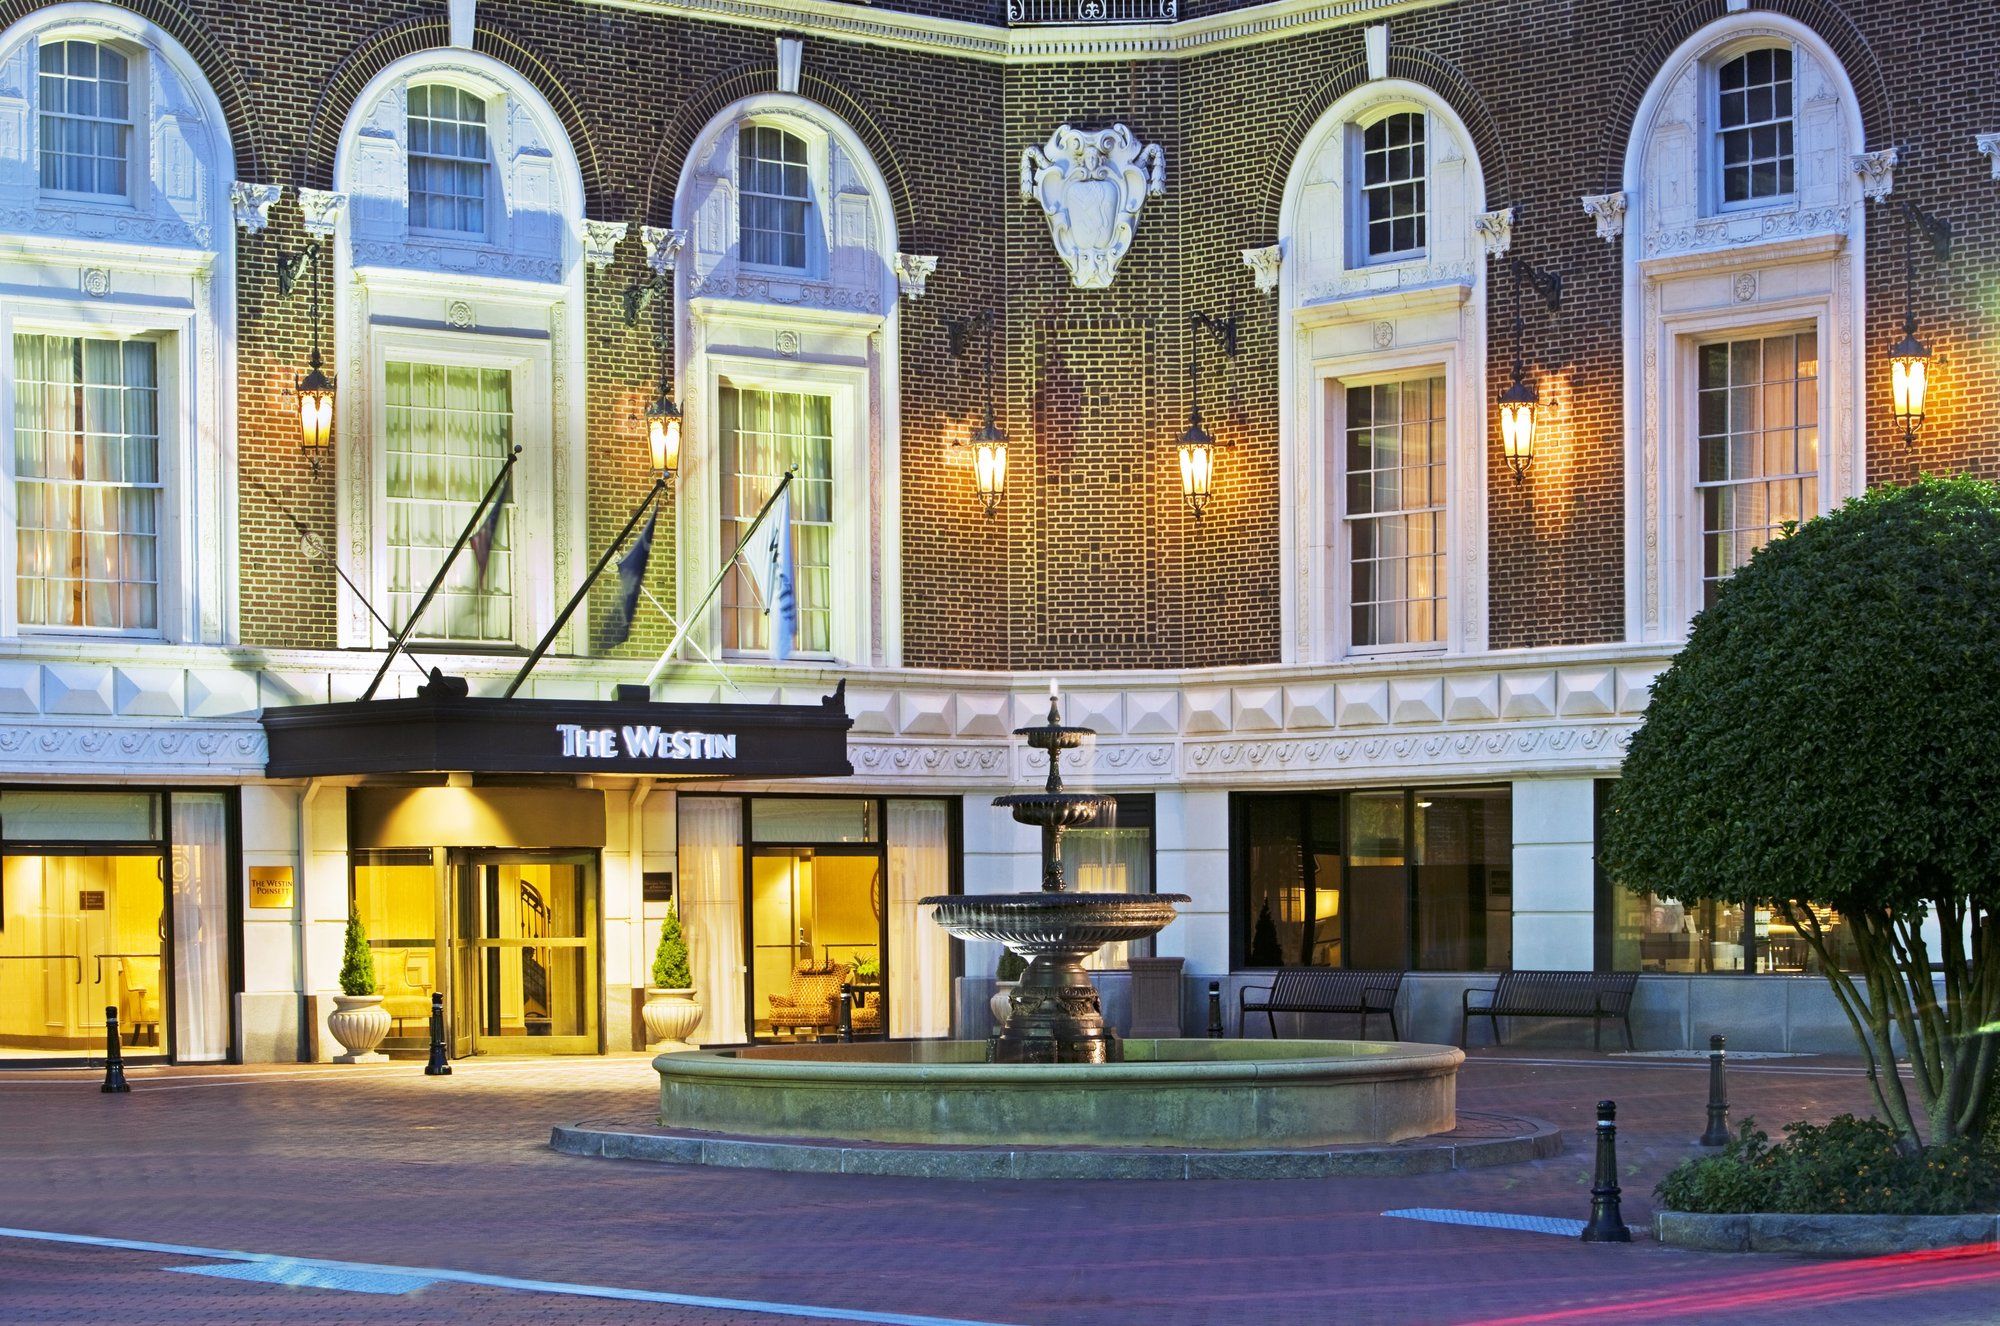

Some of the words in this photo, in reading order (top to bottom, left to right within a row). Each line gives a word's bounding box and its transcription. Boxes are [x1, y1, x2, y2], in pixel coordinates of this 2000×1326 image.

[556, 724, 618, 758] THE
[622, 725, 736, 759] WESTIN
[257, 887, 289, 895] POINSETT
